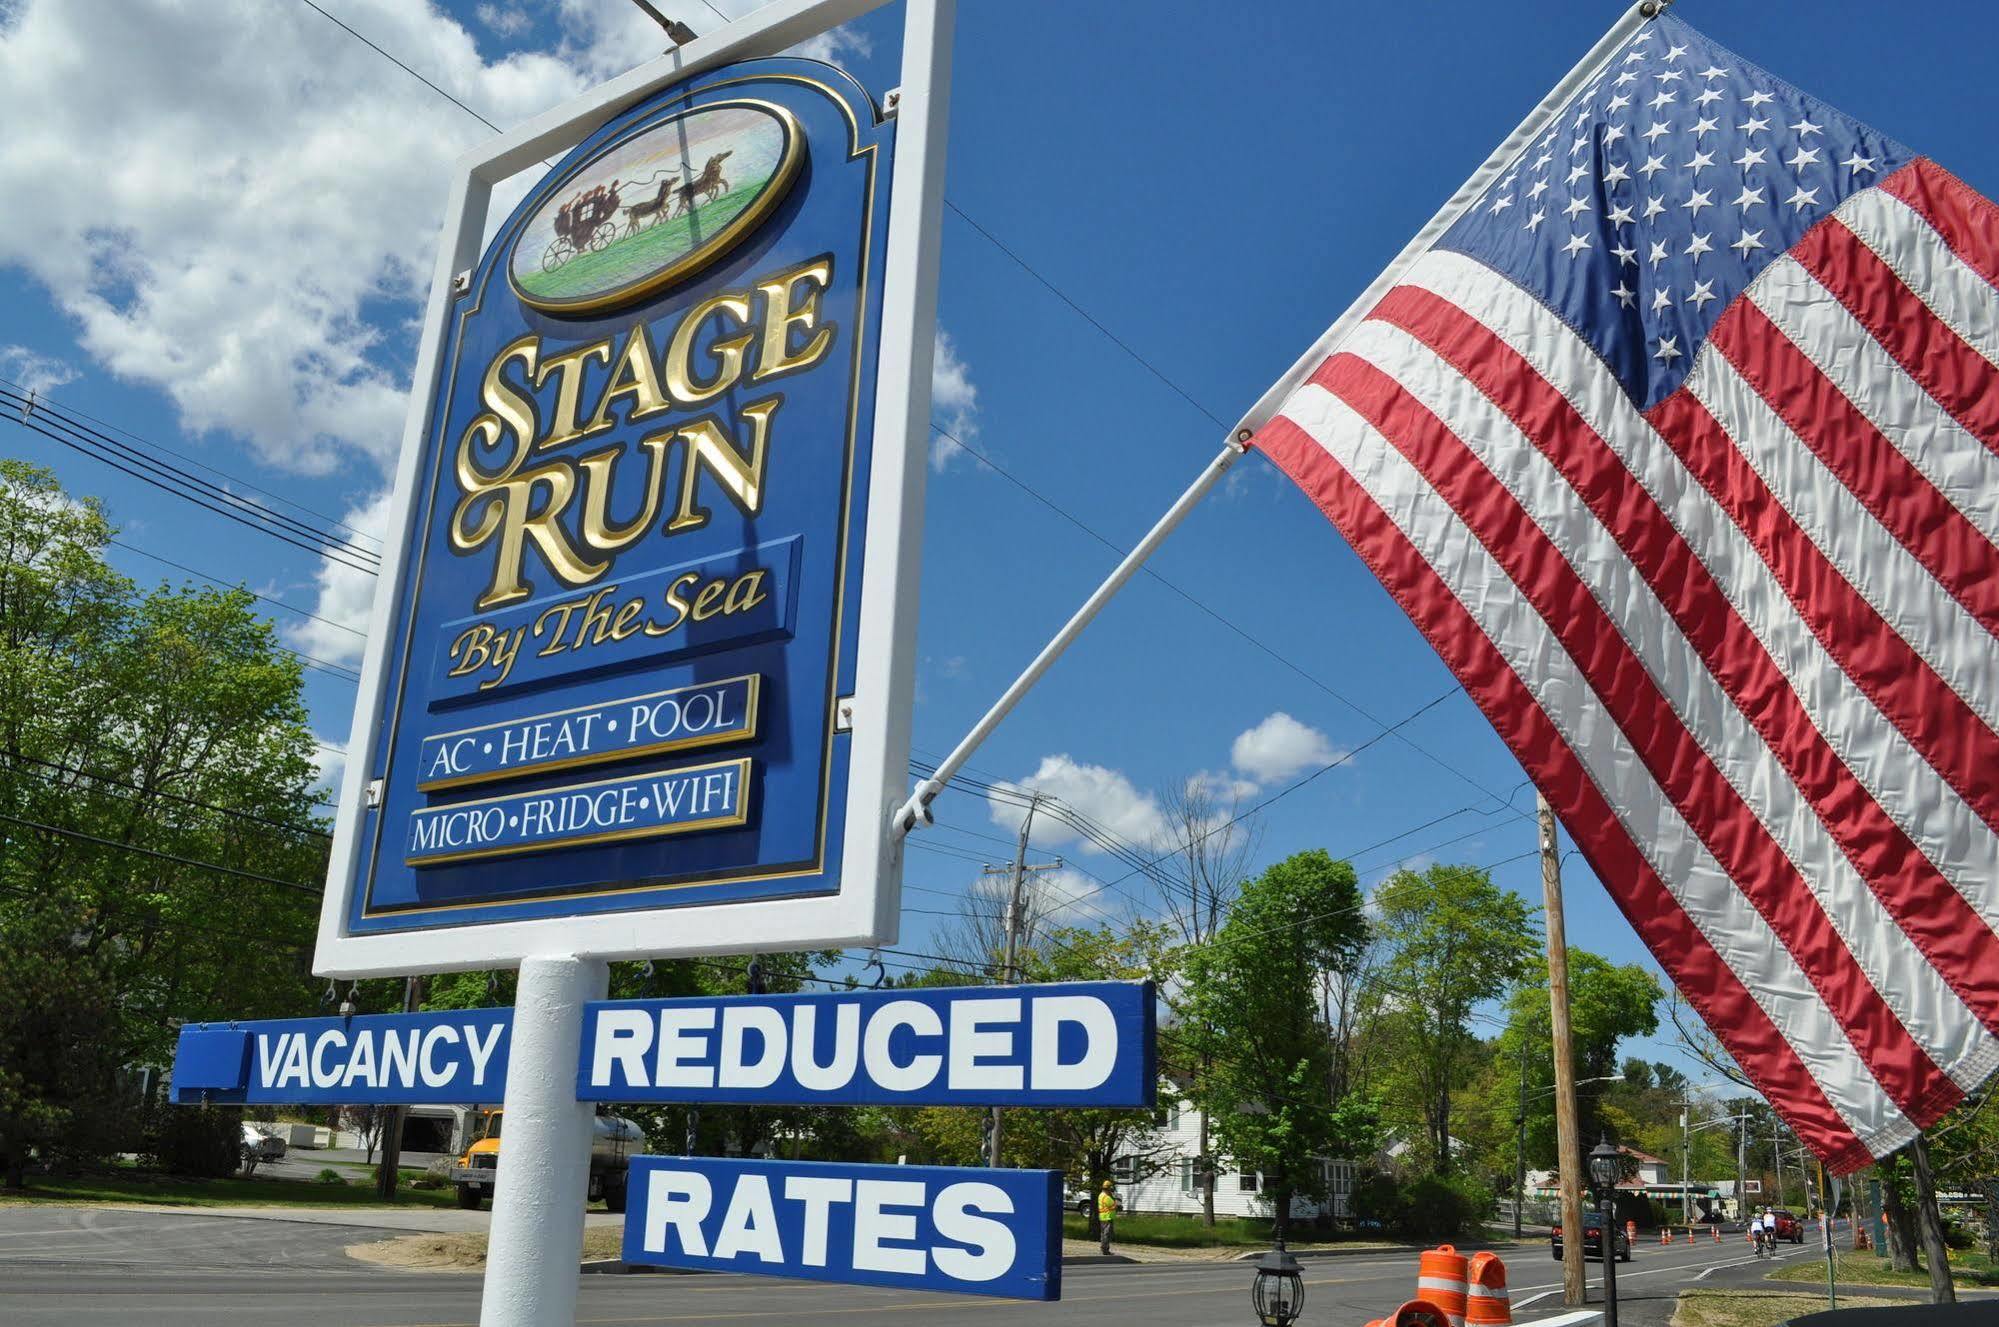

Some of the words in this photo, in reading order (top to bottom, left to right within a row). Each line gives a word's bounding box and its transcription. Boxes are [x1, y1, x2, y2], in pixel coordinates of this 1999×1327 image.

[455, 259, 832, 492] STAGE
[452, 399, 780, 608] RUN
[448, 622, 526, 691] By
[533, 584, 643, 657] The
[644, 569, 767, 636] Sea
[428, 738, 476, 776] AC
[500, 713, 601, 764] HEAT
[628, 689, 735, 742] POOL
[412, 807, 504, 850] MICRO
[520, 786, 637, 836] FRIDGE
[652, 772, 733, 818] WIFI
[258, 1023, 505, 1088] VACANCY
[591, 995, 1118, 1091] REDUCED
[643, 1169, 1017, 1282] RATES
